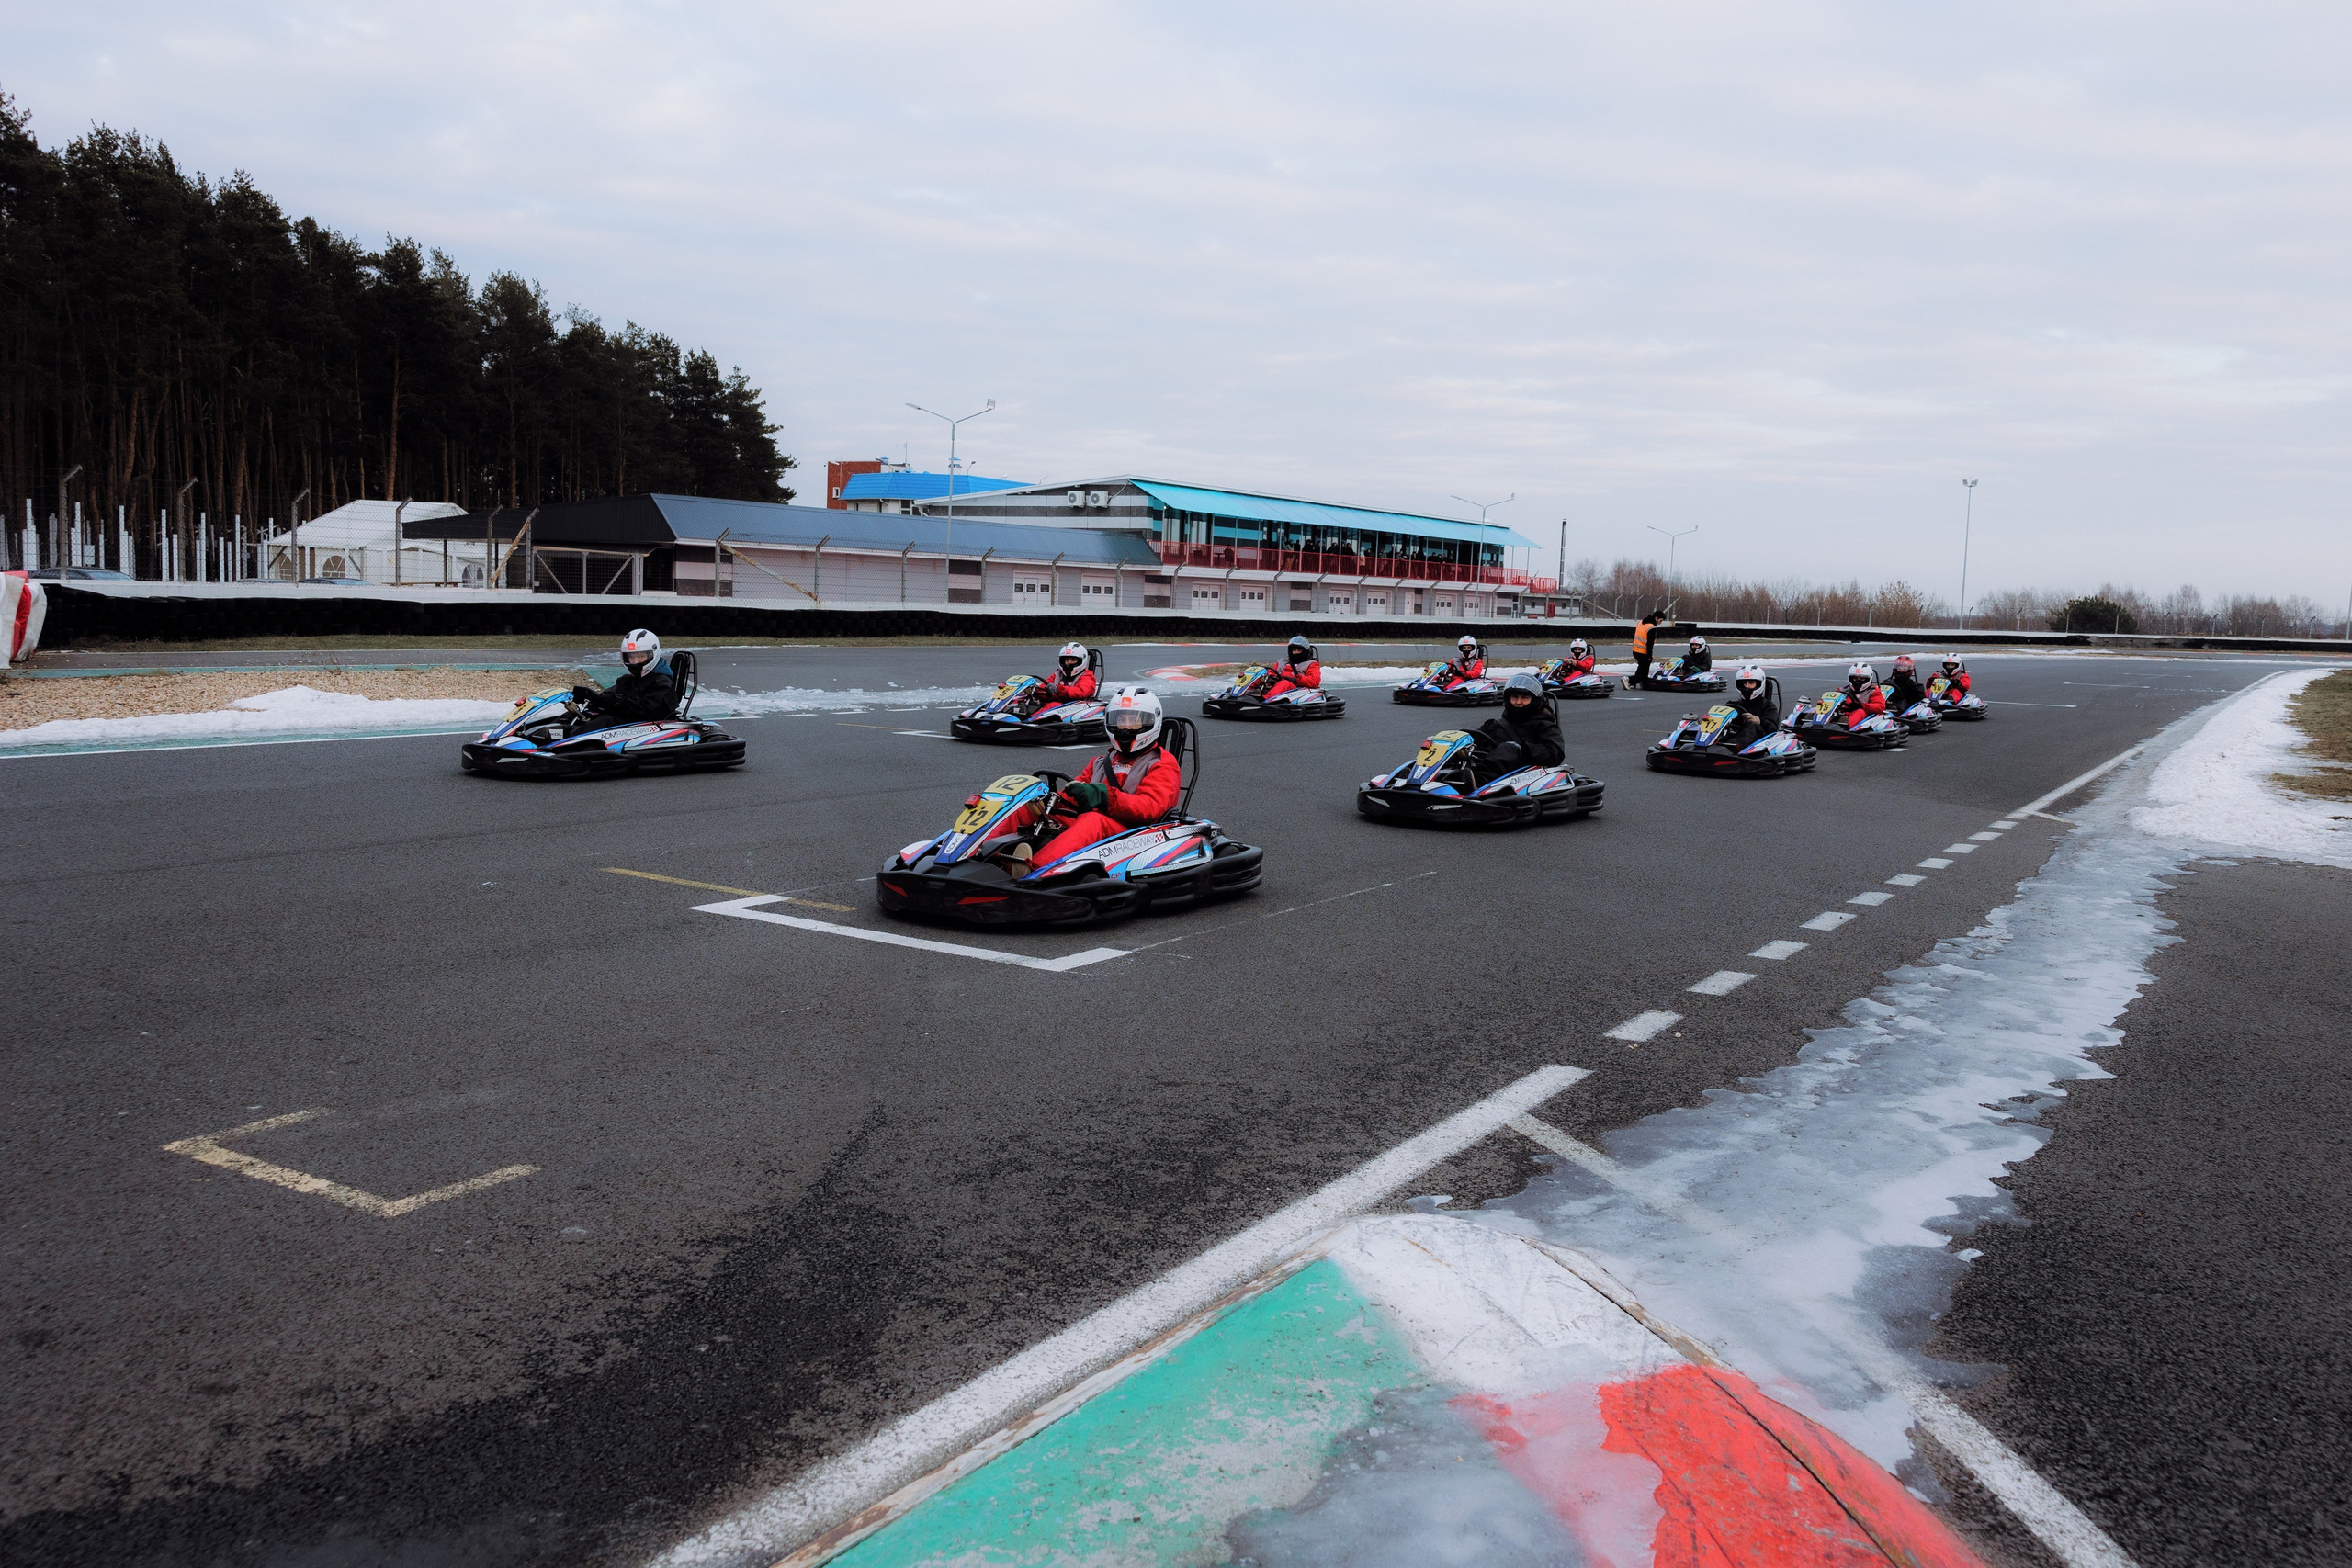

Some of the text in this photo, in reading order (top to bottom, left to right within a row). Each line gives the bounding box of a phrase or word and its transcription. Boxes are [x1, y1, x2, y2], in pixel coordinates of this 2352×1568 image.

[1704, 721, 1718, 729] 17
[1424, 750, 1437, 761] 2
[995, 776, 1030, 791] 12
[962, 809, 989, 826] 12
[1098, 835, 1156, 859] ADMRACEWAY
